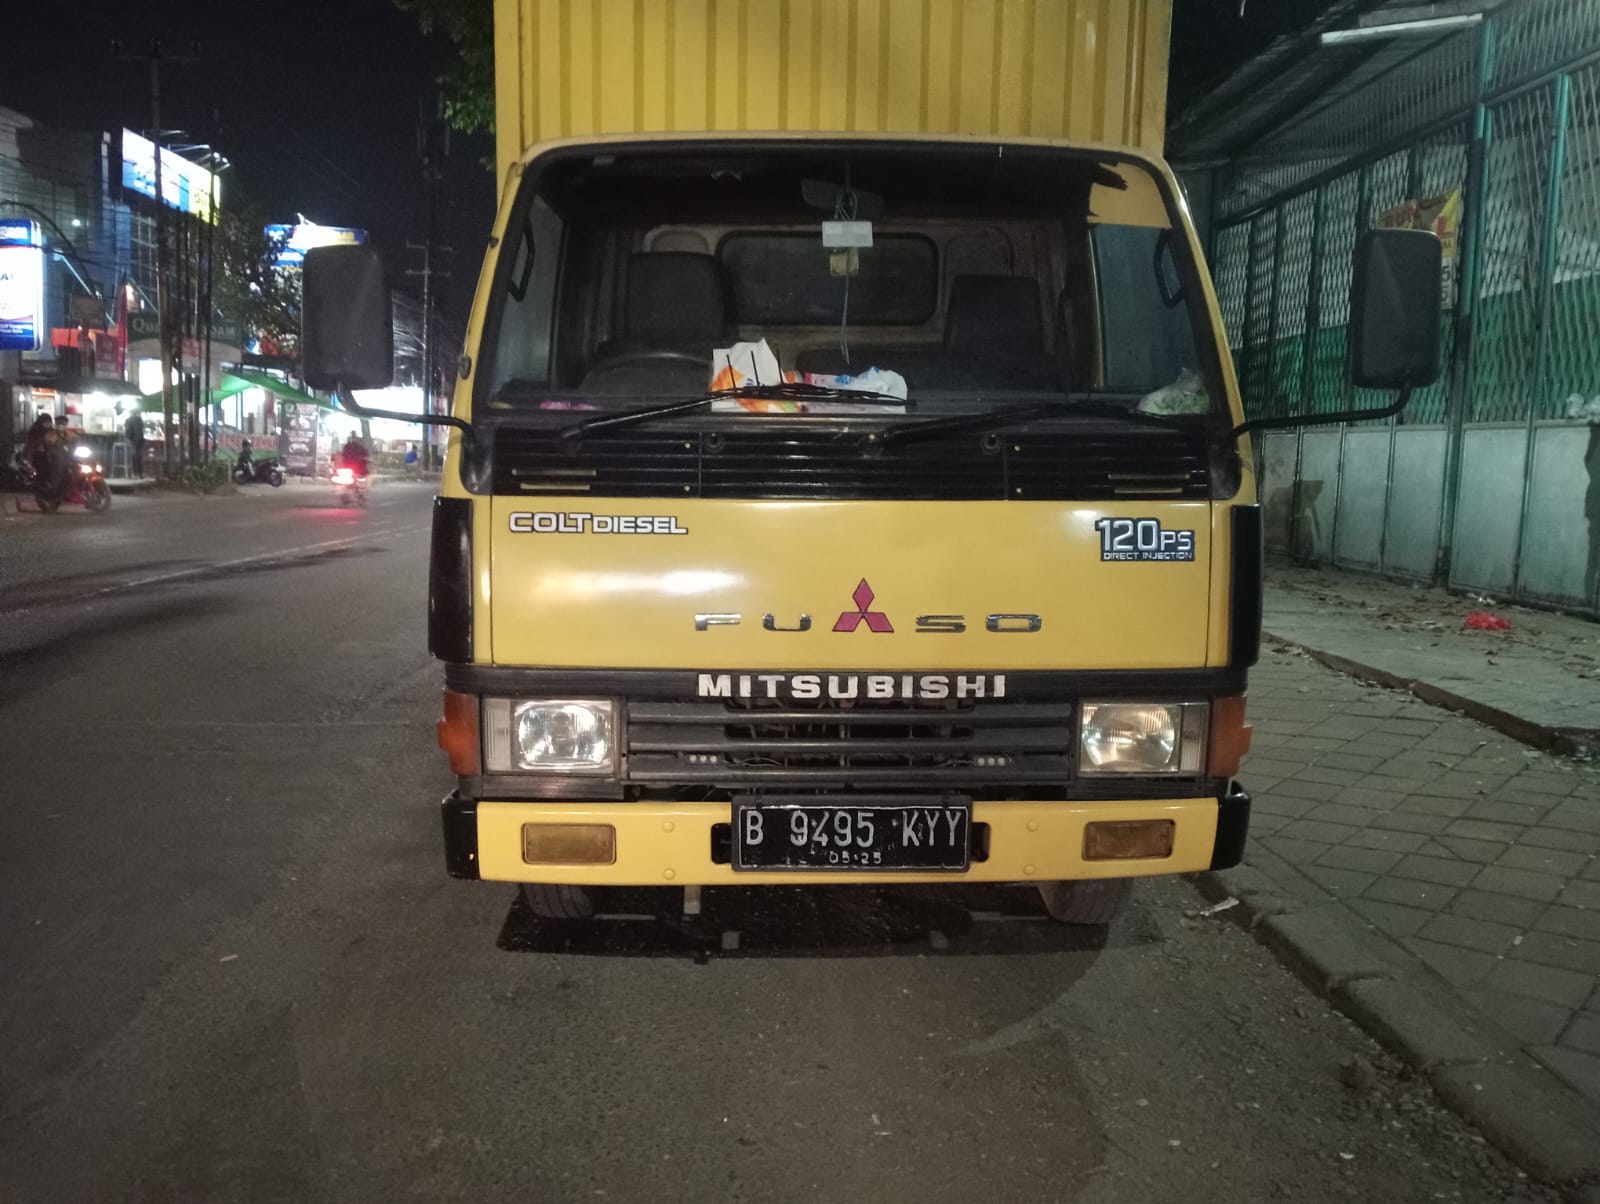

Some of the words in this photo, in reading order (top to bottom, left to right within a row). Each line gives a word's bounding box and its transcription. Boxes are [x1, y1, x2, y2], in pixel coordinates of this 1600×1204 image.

[1103, 552, 1138, 560] DIRECT
[1142, 552, 1192, 560] INJECTION
[698, 673, 1006, 699] MITSUBISHI
[745, 810, 764, 846] B
[790, 811, 875, 847] 9495
[902, 811, 962, 847] KYY
